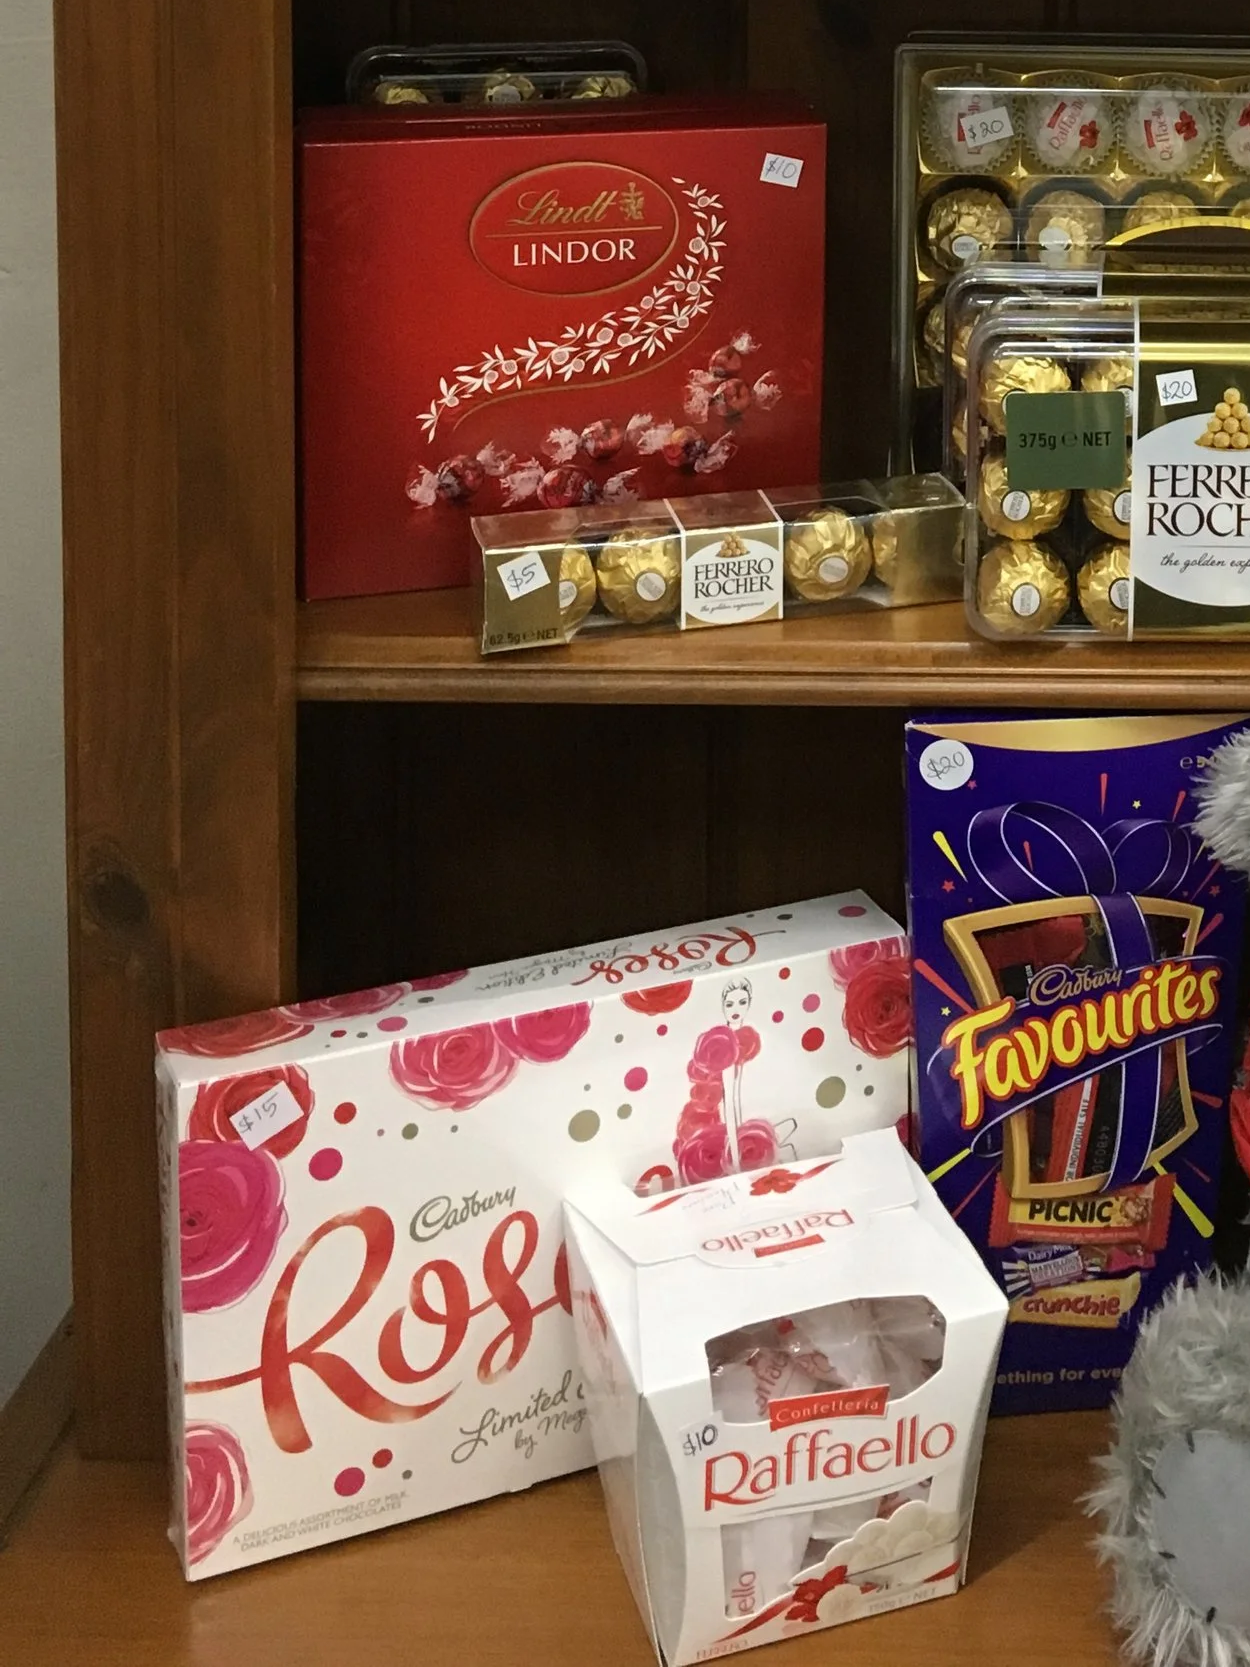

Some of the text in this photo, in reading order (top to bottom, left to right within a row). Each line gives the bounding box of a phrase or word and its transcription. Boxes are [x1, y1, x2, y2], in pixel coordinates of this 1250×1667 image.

[968, 119, 1004, 143] $20
[765, 157, 798, 180] $10
[507, 189, 618, 226] Lindt
[513, 238, 637, 266] LINDOR
[1162, 380, 1193, 400] $20
[1019, 431, 1112, 450] 375g NET
[694, 556, 774, 583] FERRERO
[1160, 552, 1179, 566] the
[1180, 552, 1226, 573] golden
[507, 563, 537, 591] $5
[694, 575, 774, 599] ROCHER
[927, 750, 965, 781] $20
[571, 925, 785, 987] Roses
[1030, 968, 1122, 1006] Cadbury
[943, 962, 1220, 1128] Favourites
[239, 1094, 279, 1132] $15
[409, 1186, 517, 1243] Cadbury
[1029, 1199, 1113, 1223] PICNIC
[701, 1208, 856, 1254] Raffaello
[1023, 1295, 1120, 1316] crunchie
[1060, 1368, 1085, 1381] for
[451, 1369, 572, 1463] Limited
[683, 1423, 718, 1457] $10
[704, 1413, 956, 1512] Raffaello
[243, 1521, 299, 1543] DELICIOUS
[299, 1501, 366, 1526] ASSORTMENT
[333, 1500, 403, 1526] CHOCOLATES
